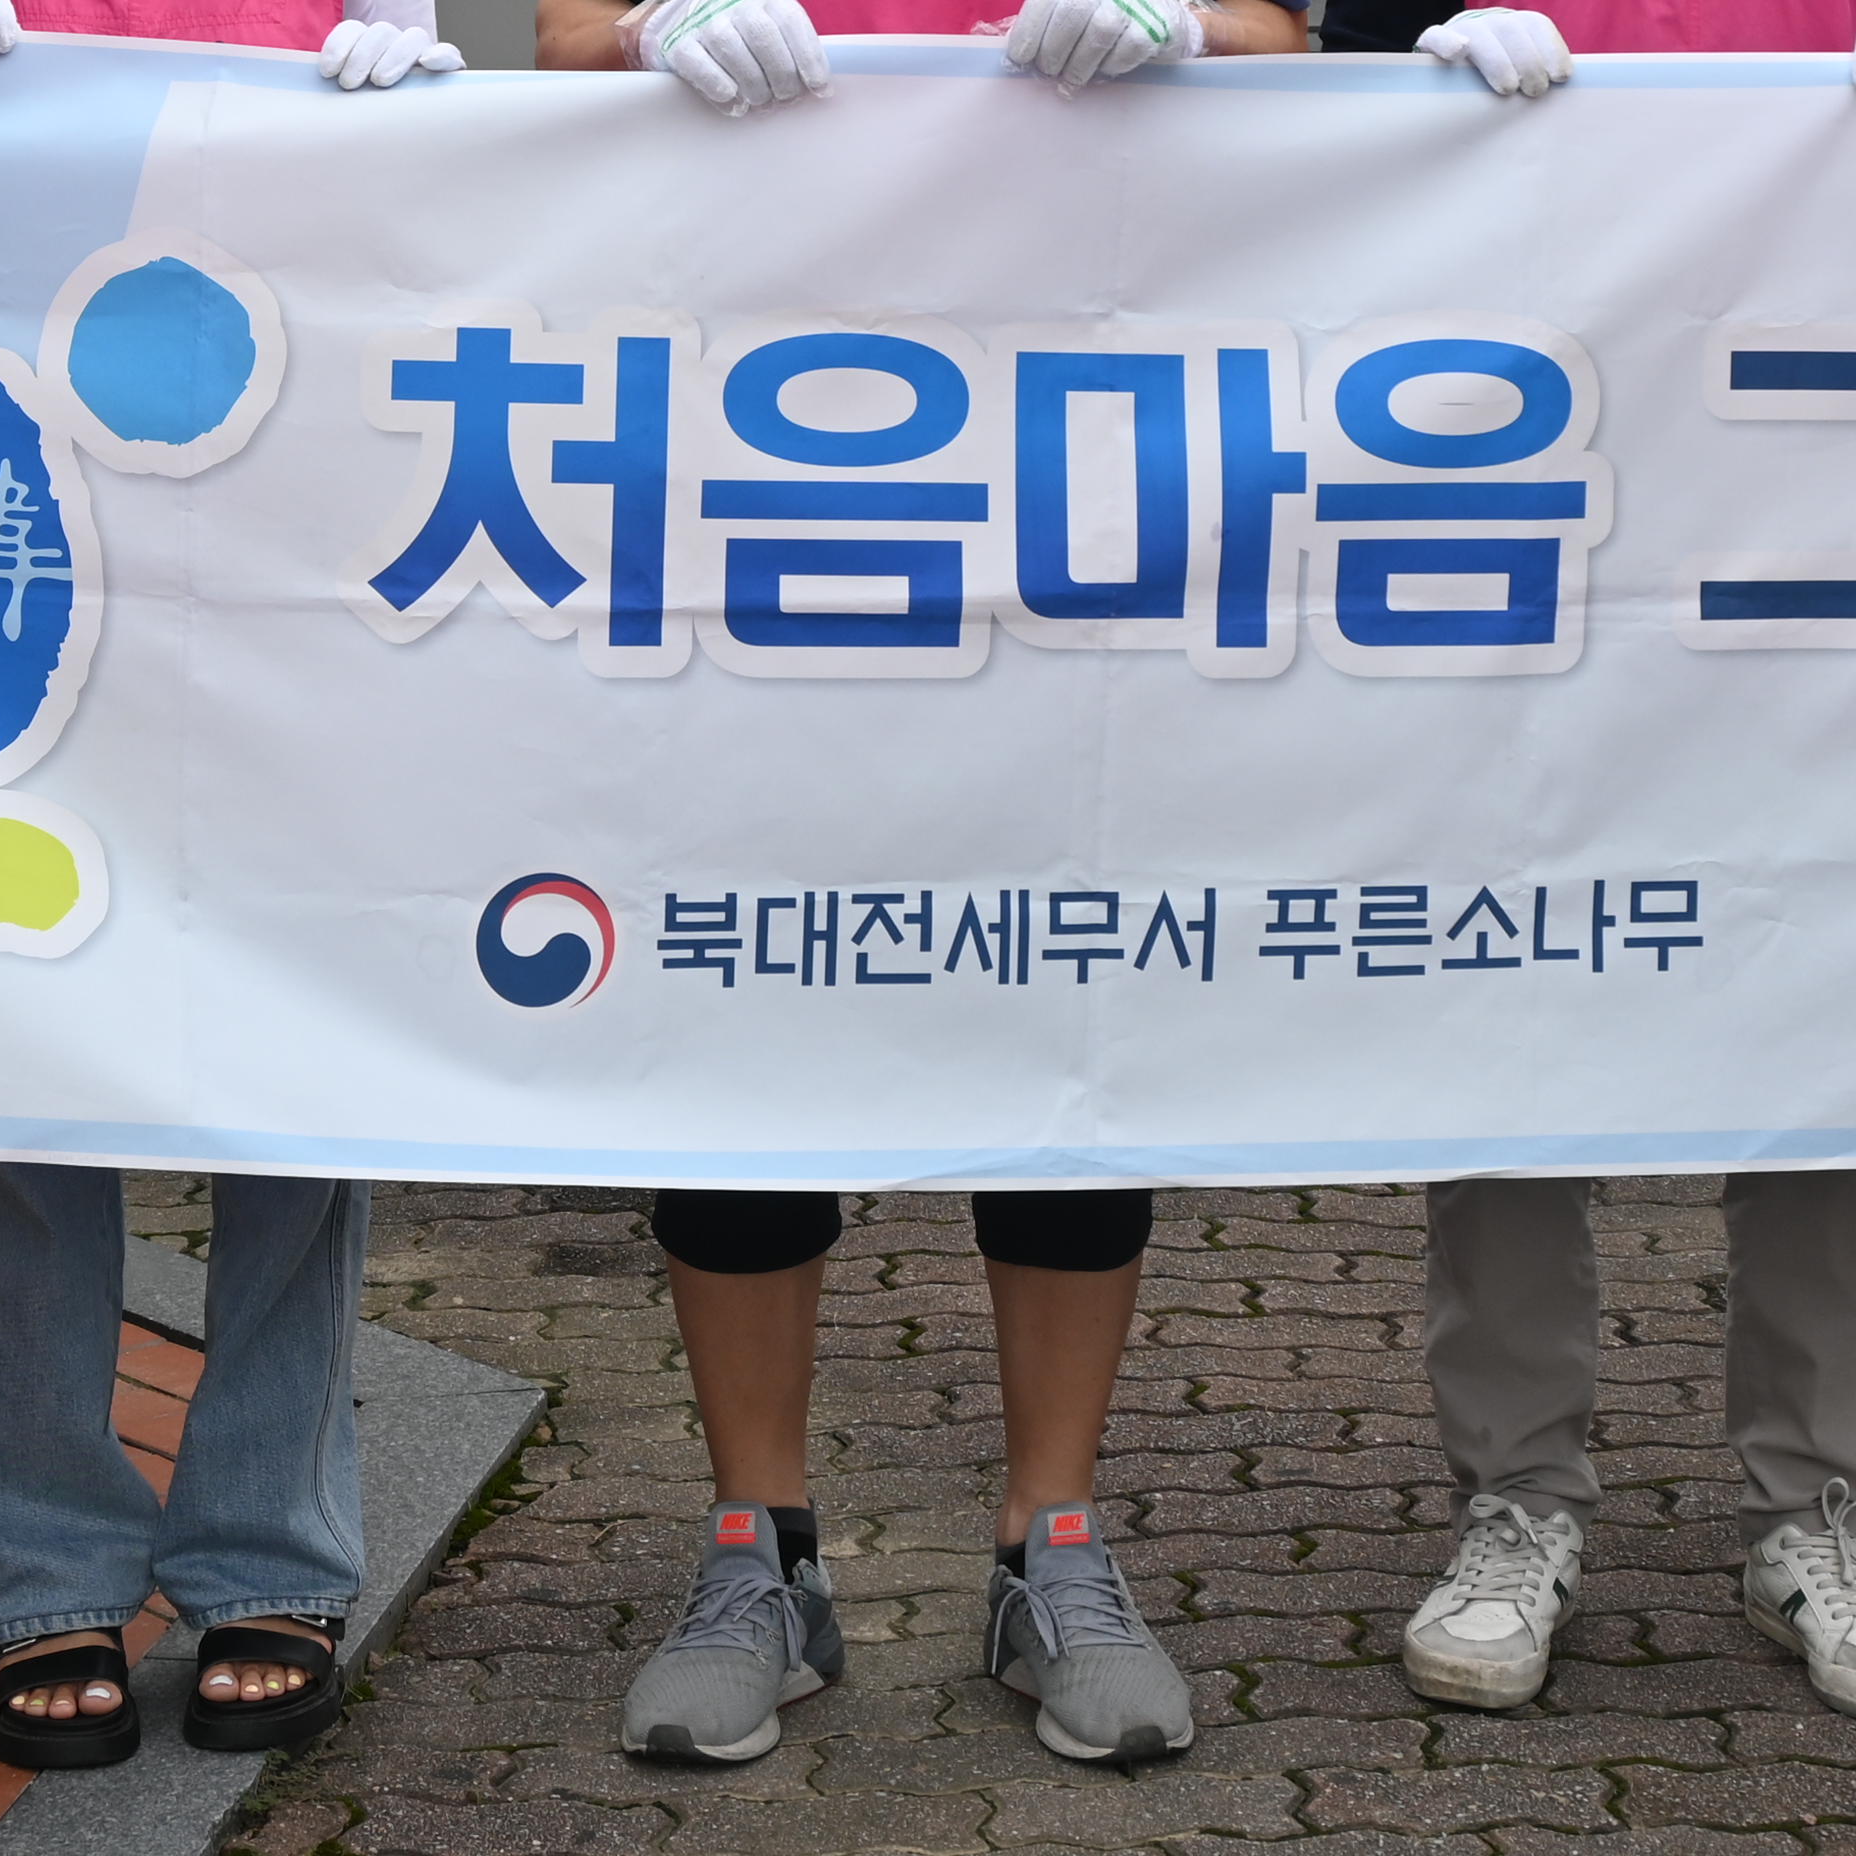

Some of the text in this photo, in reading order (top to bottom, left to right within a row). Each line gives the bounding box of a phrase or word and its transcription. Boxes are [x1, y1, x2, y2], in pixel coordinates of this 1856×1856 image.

[367, 327, 1588, 649] 처음마음
[656, 879, 1704, 989] 북대전세무서 푸른소나무
